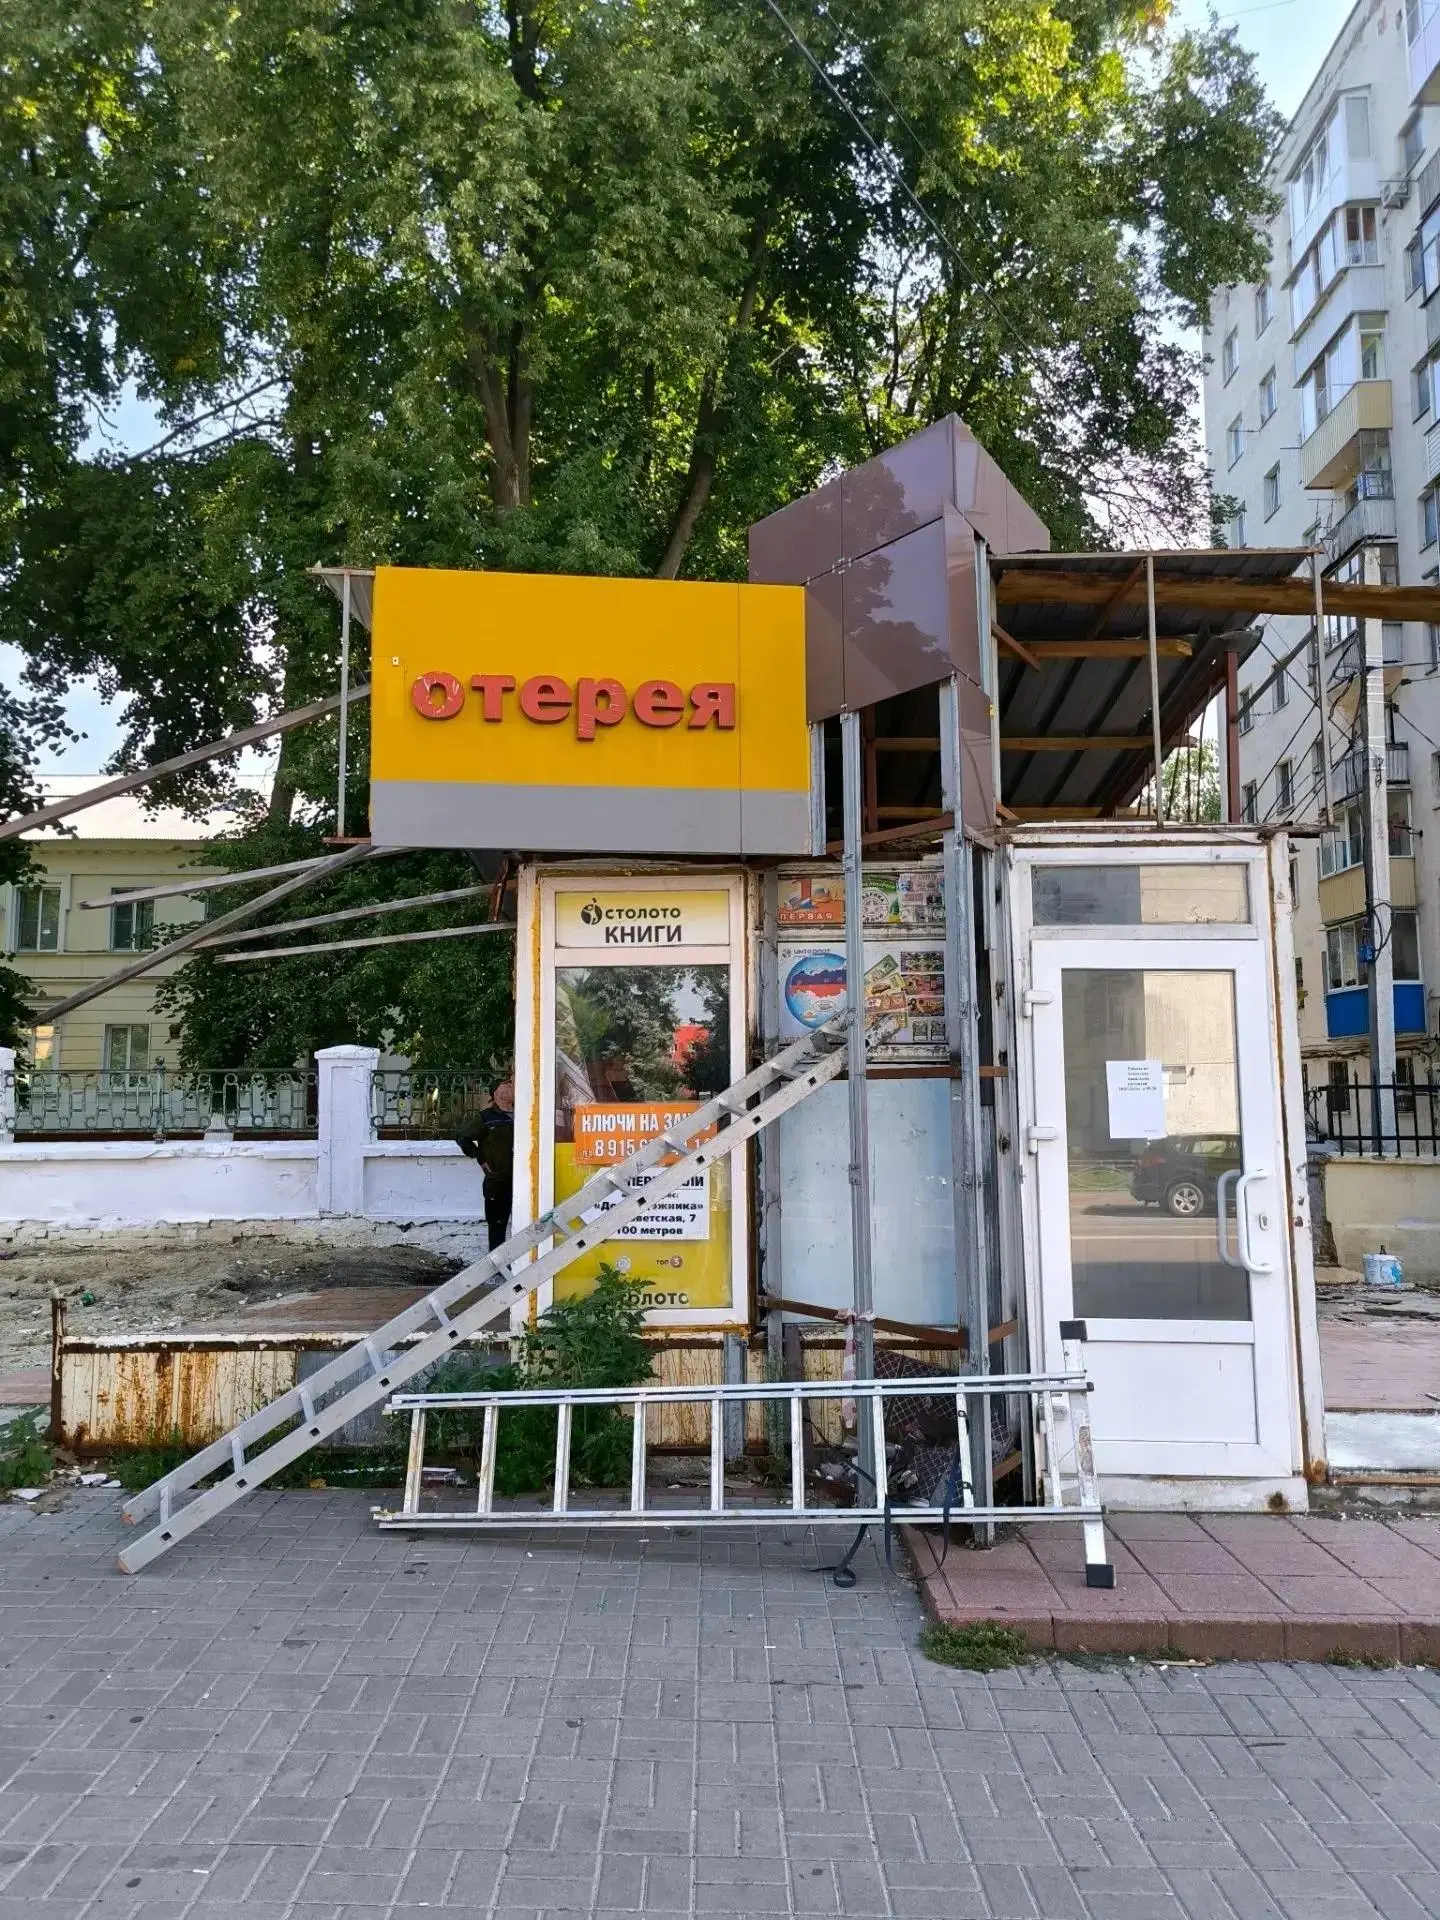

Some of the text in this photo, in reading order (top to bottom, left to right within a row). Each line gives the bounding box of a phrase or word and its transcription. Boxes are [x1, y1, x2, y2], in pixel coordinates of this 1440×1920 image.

[411, 671, 736, 742] отерея
[780, 912, 833, 920] ПЕРВАЯ
[605, 925, 683, 943] КНИГИ
[581, 1114, 636, 1132] КЛЮЧИ
[640, 1113, 659, 1131] НА
[689, 1213, 697, 1222] 7
[640, 1227, 684, 1237] метров
